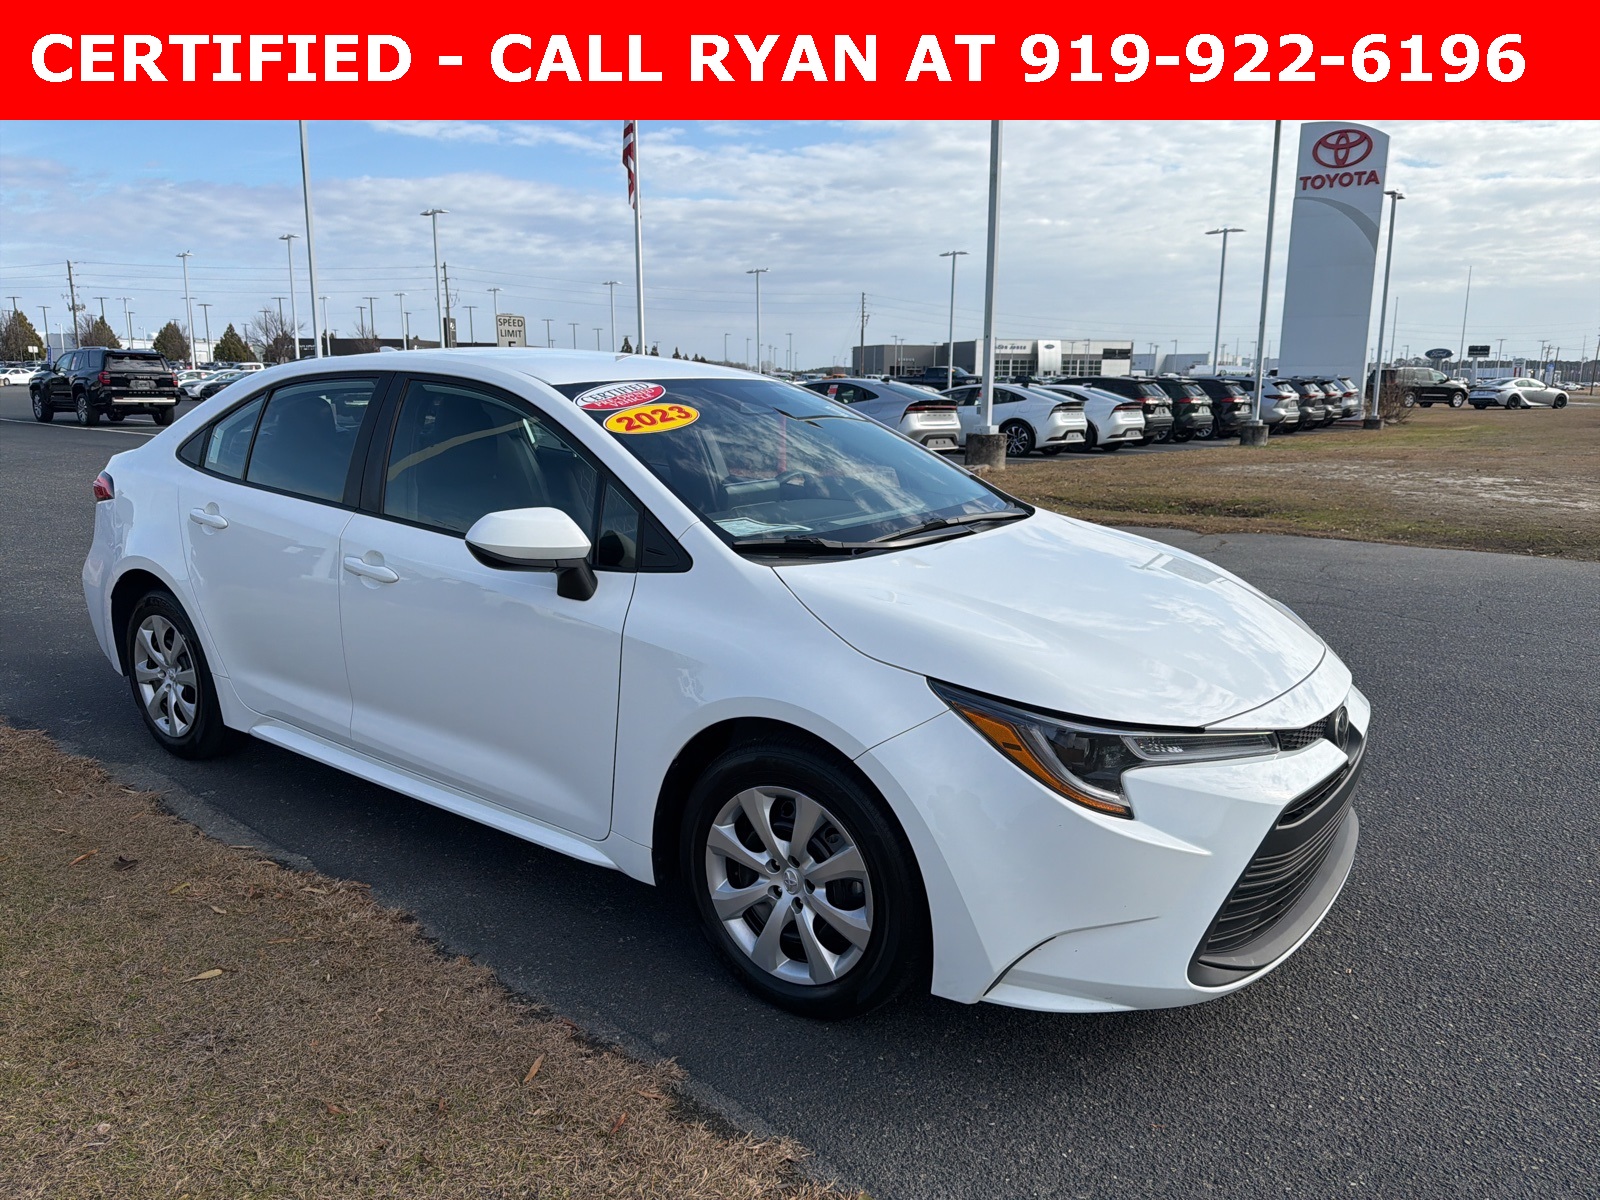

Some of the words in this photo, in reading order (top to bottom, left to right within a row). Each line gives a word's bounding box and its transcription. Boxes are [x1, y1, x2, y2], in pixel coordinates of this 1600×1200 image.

[1300, 170, 1380, 191] TOYOTA
[498, 318, 523, 327] SPEED
[500, 329, 522, 338] LIMIT
[580, 383, 650, 403] CERTIFIED
[608, 393, 655, 407] VEHICLE
[616, 405, 692, 432] 2023
